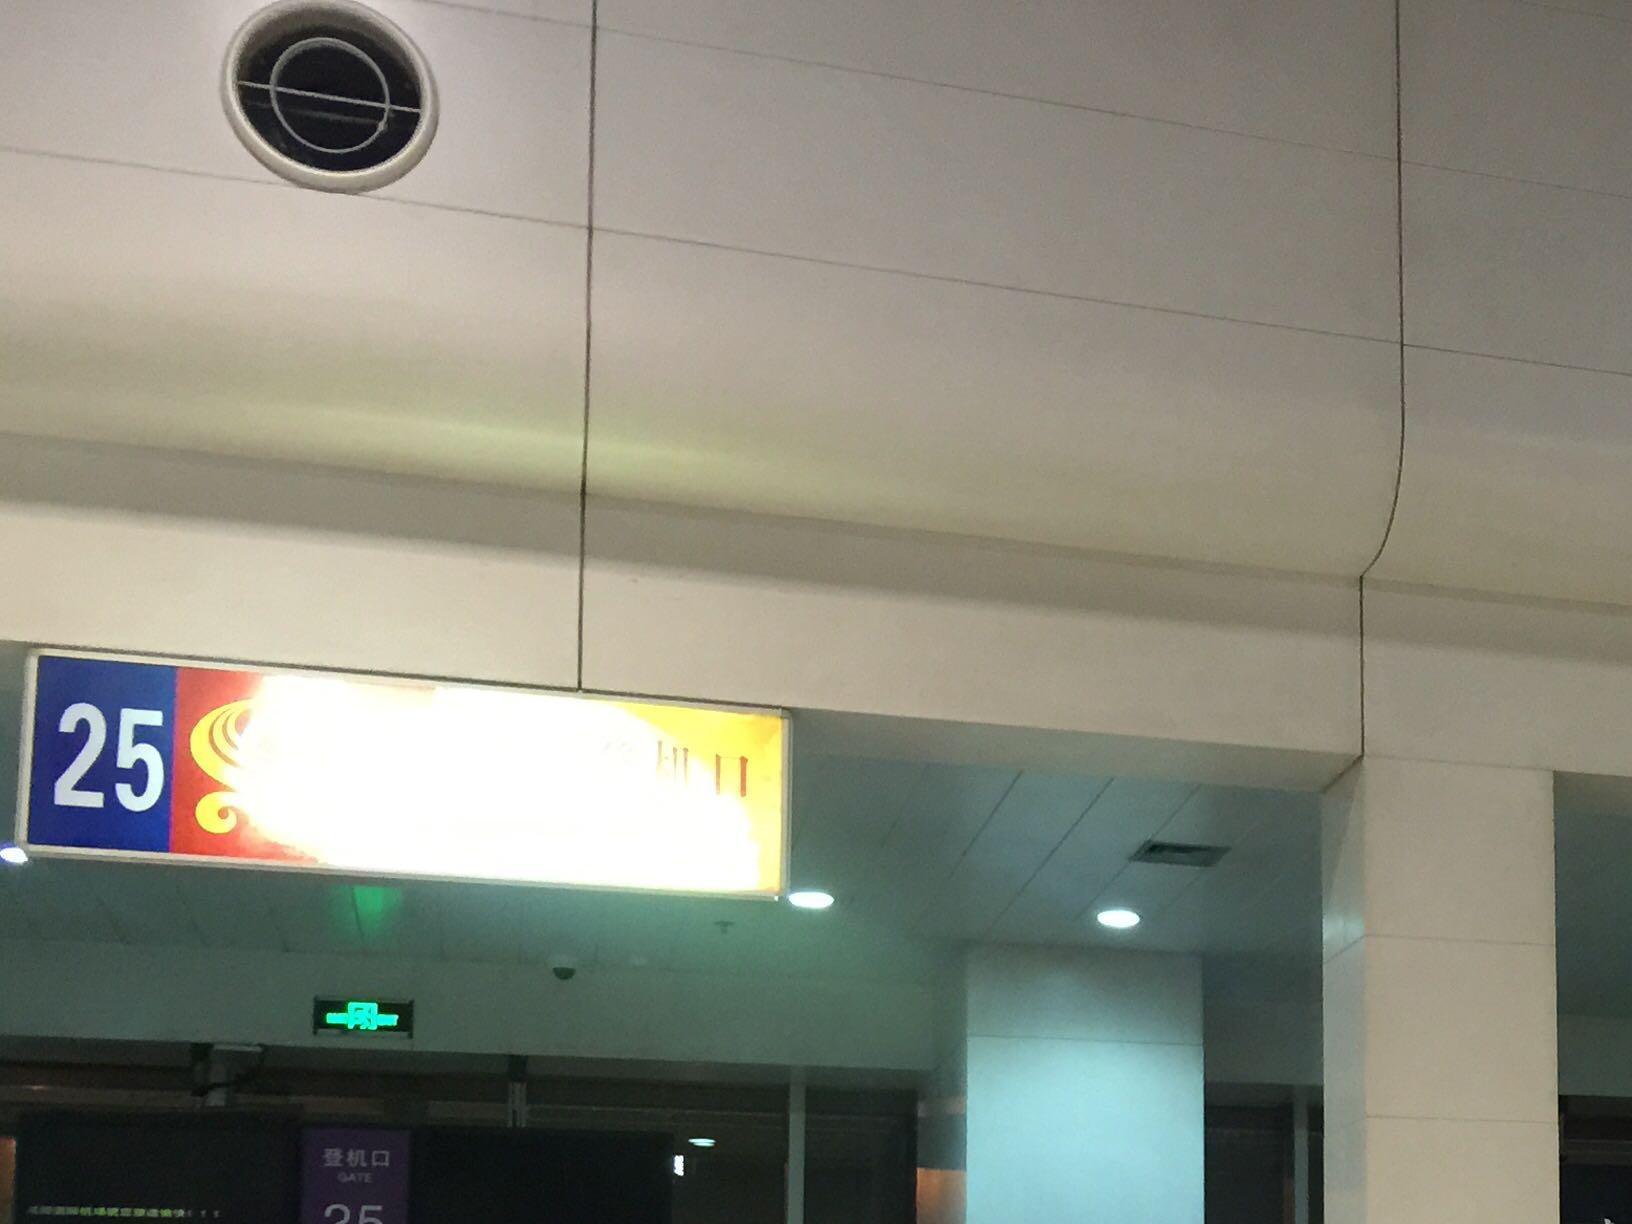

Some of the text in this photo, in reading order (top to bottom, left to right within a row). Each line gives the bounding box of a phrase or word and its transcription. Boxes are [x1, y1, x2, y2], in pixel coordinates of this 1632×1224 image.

[54, 702, 165, 812] 25
[322, 1147, 391, 1169] 登机口
[337, 1172, 374, 1184] GATE
